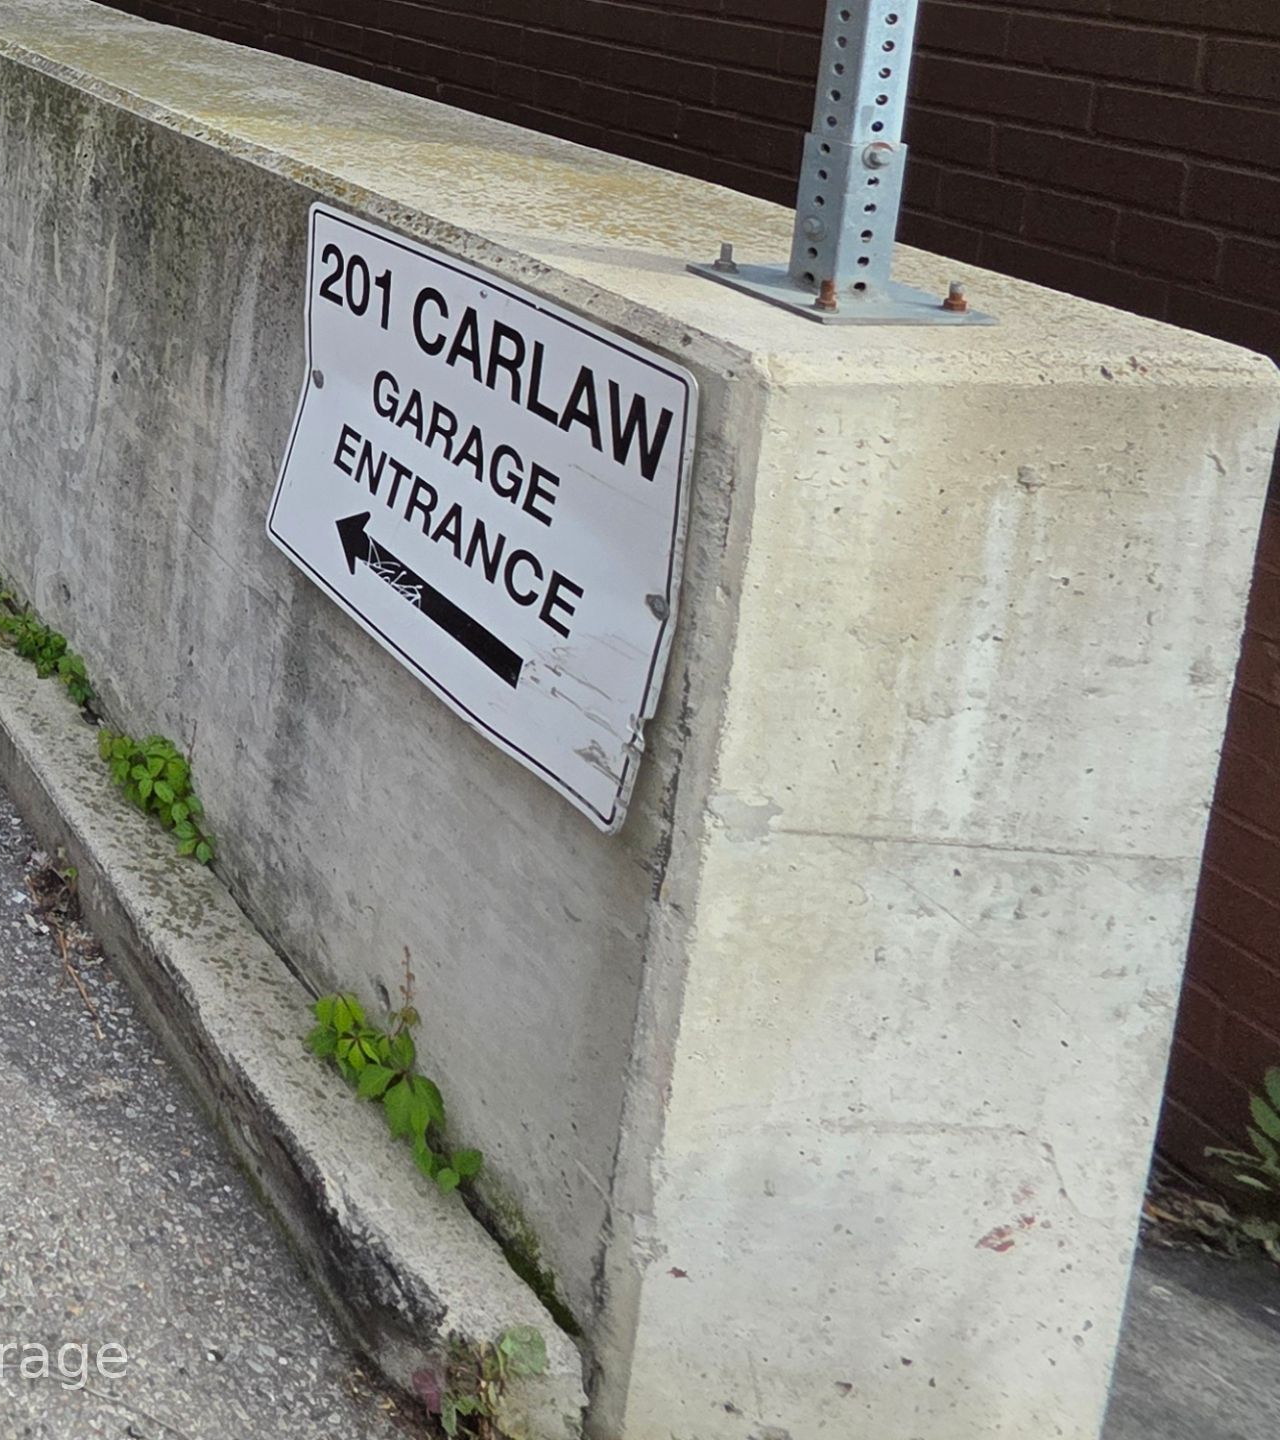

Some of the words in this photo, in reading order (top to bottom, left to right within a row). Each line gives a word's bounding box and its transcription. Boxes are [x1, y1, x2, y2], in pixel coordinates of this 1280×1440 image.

[318, 243, 392, 330] 201
[412, 287, 673, 481] CARLAW
[372, 370, 561, 527] GARAGE
[332, 423, 584, 638] ENTRANCE
